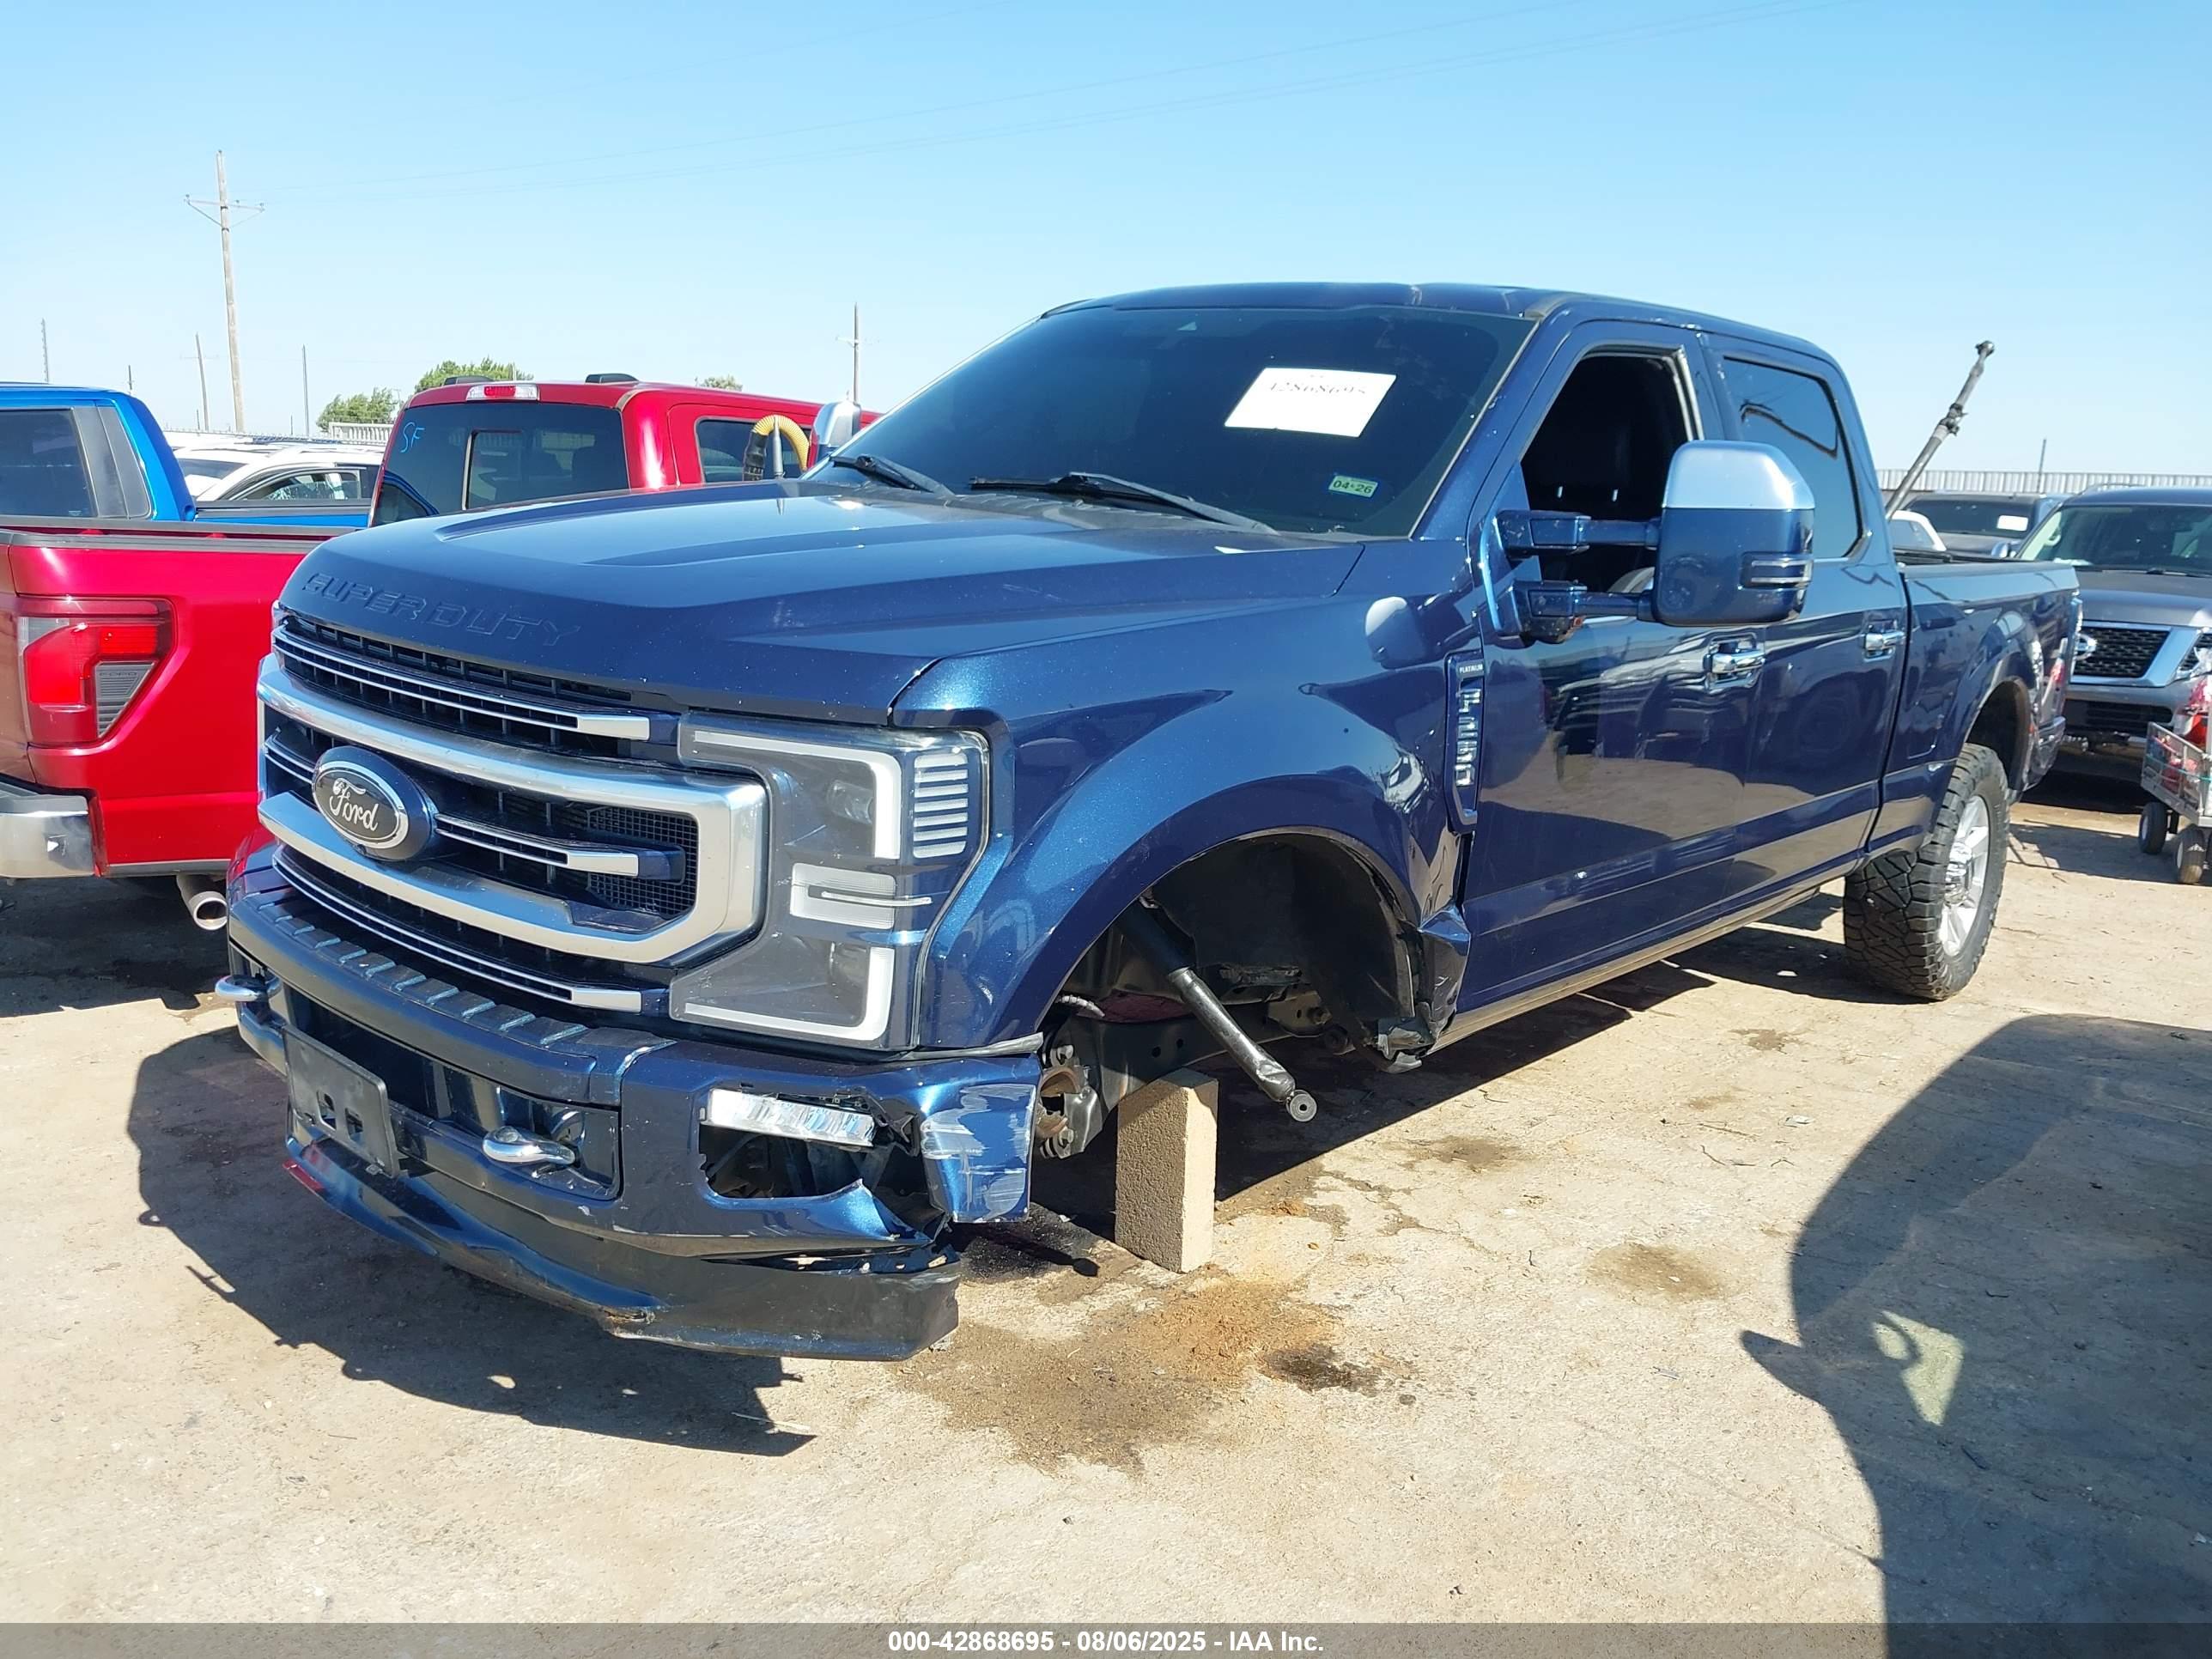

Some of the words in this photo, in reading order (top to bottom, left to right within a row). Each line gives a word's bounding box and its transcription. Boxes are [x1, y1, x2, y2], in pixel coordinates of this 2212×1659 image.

[400, 422, 425, 453] SF
[301, 572, 427, 620] SUPER
[429, 602, 580, 646] DUTY
[1459, 663, 1484, 674] PLATINUM
[329, 777, 380, 831] Ford
